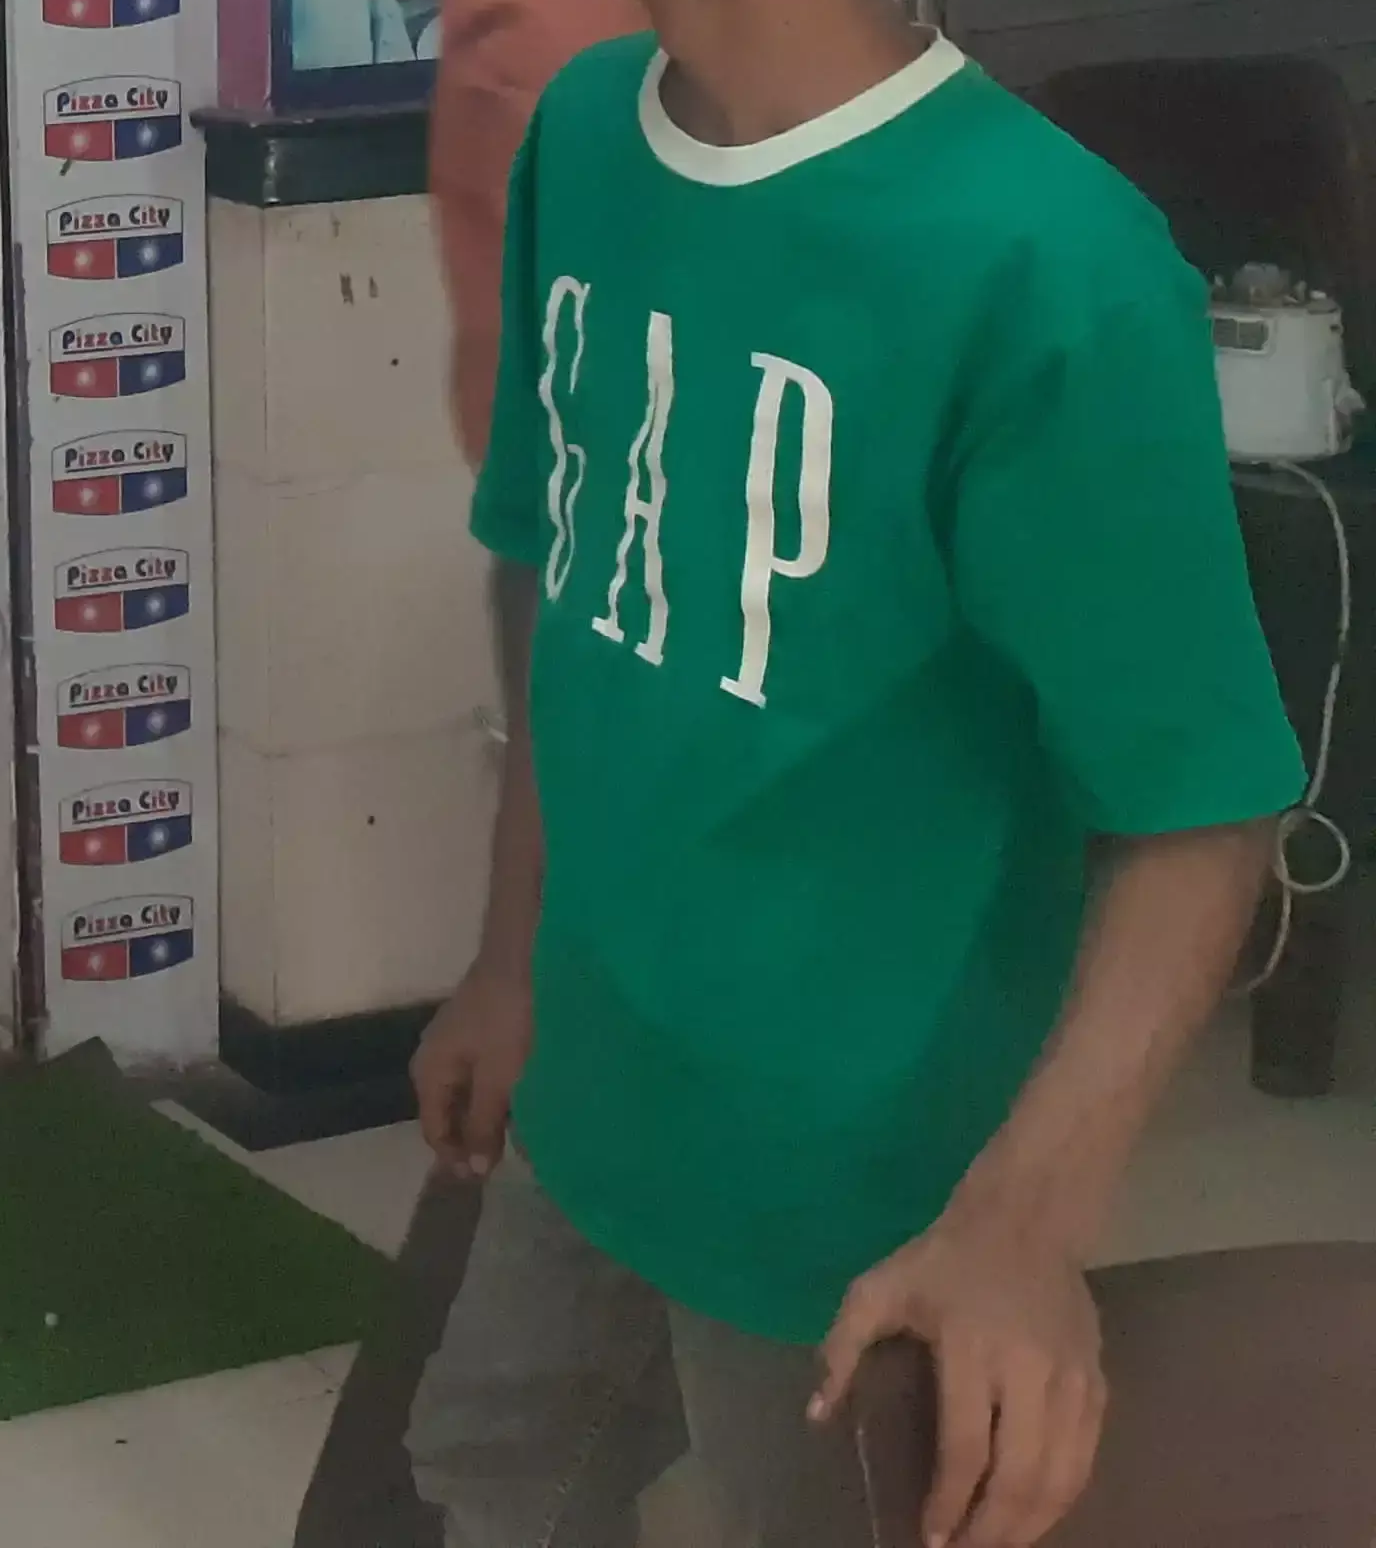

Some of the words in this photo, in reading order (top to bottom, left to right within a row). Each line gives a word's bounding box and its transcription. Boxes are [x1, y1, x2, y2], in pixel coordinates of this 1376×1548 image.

[57, 92, 118, 112] Pizza
[127, 87, 168, 109] City
[59, 211, 121, 231] Pizza
[129, 204, 170, 227] City
[63, 330, 123, 349] Pizza
[132, 324, 173, 345] City
[65, 448, 125, 468] Pizza
[133, 440, 174, 462] City
[538, 275, 834, 710] GAP
[68, 565, 128, 585] Pizza
[136, 558, 177, 579] City
